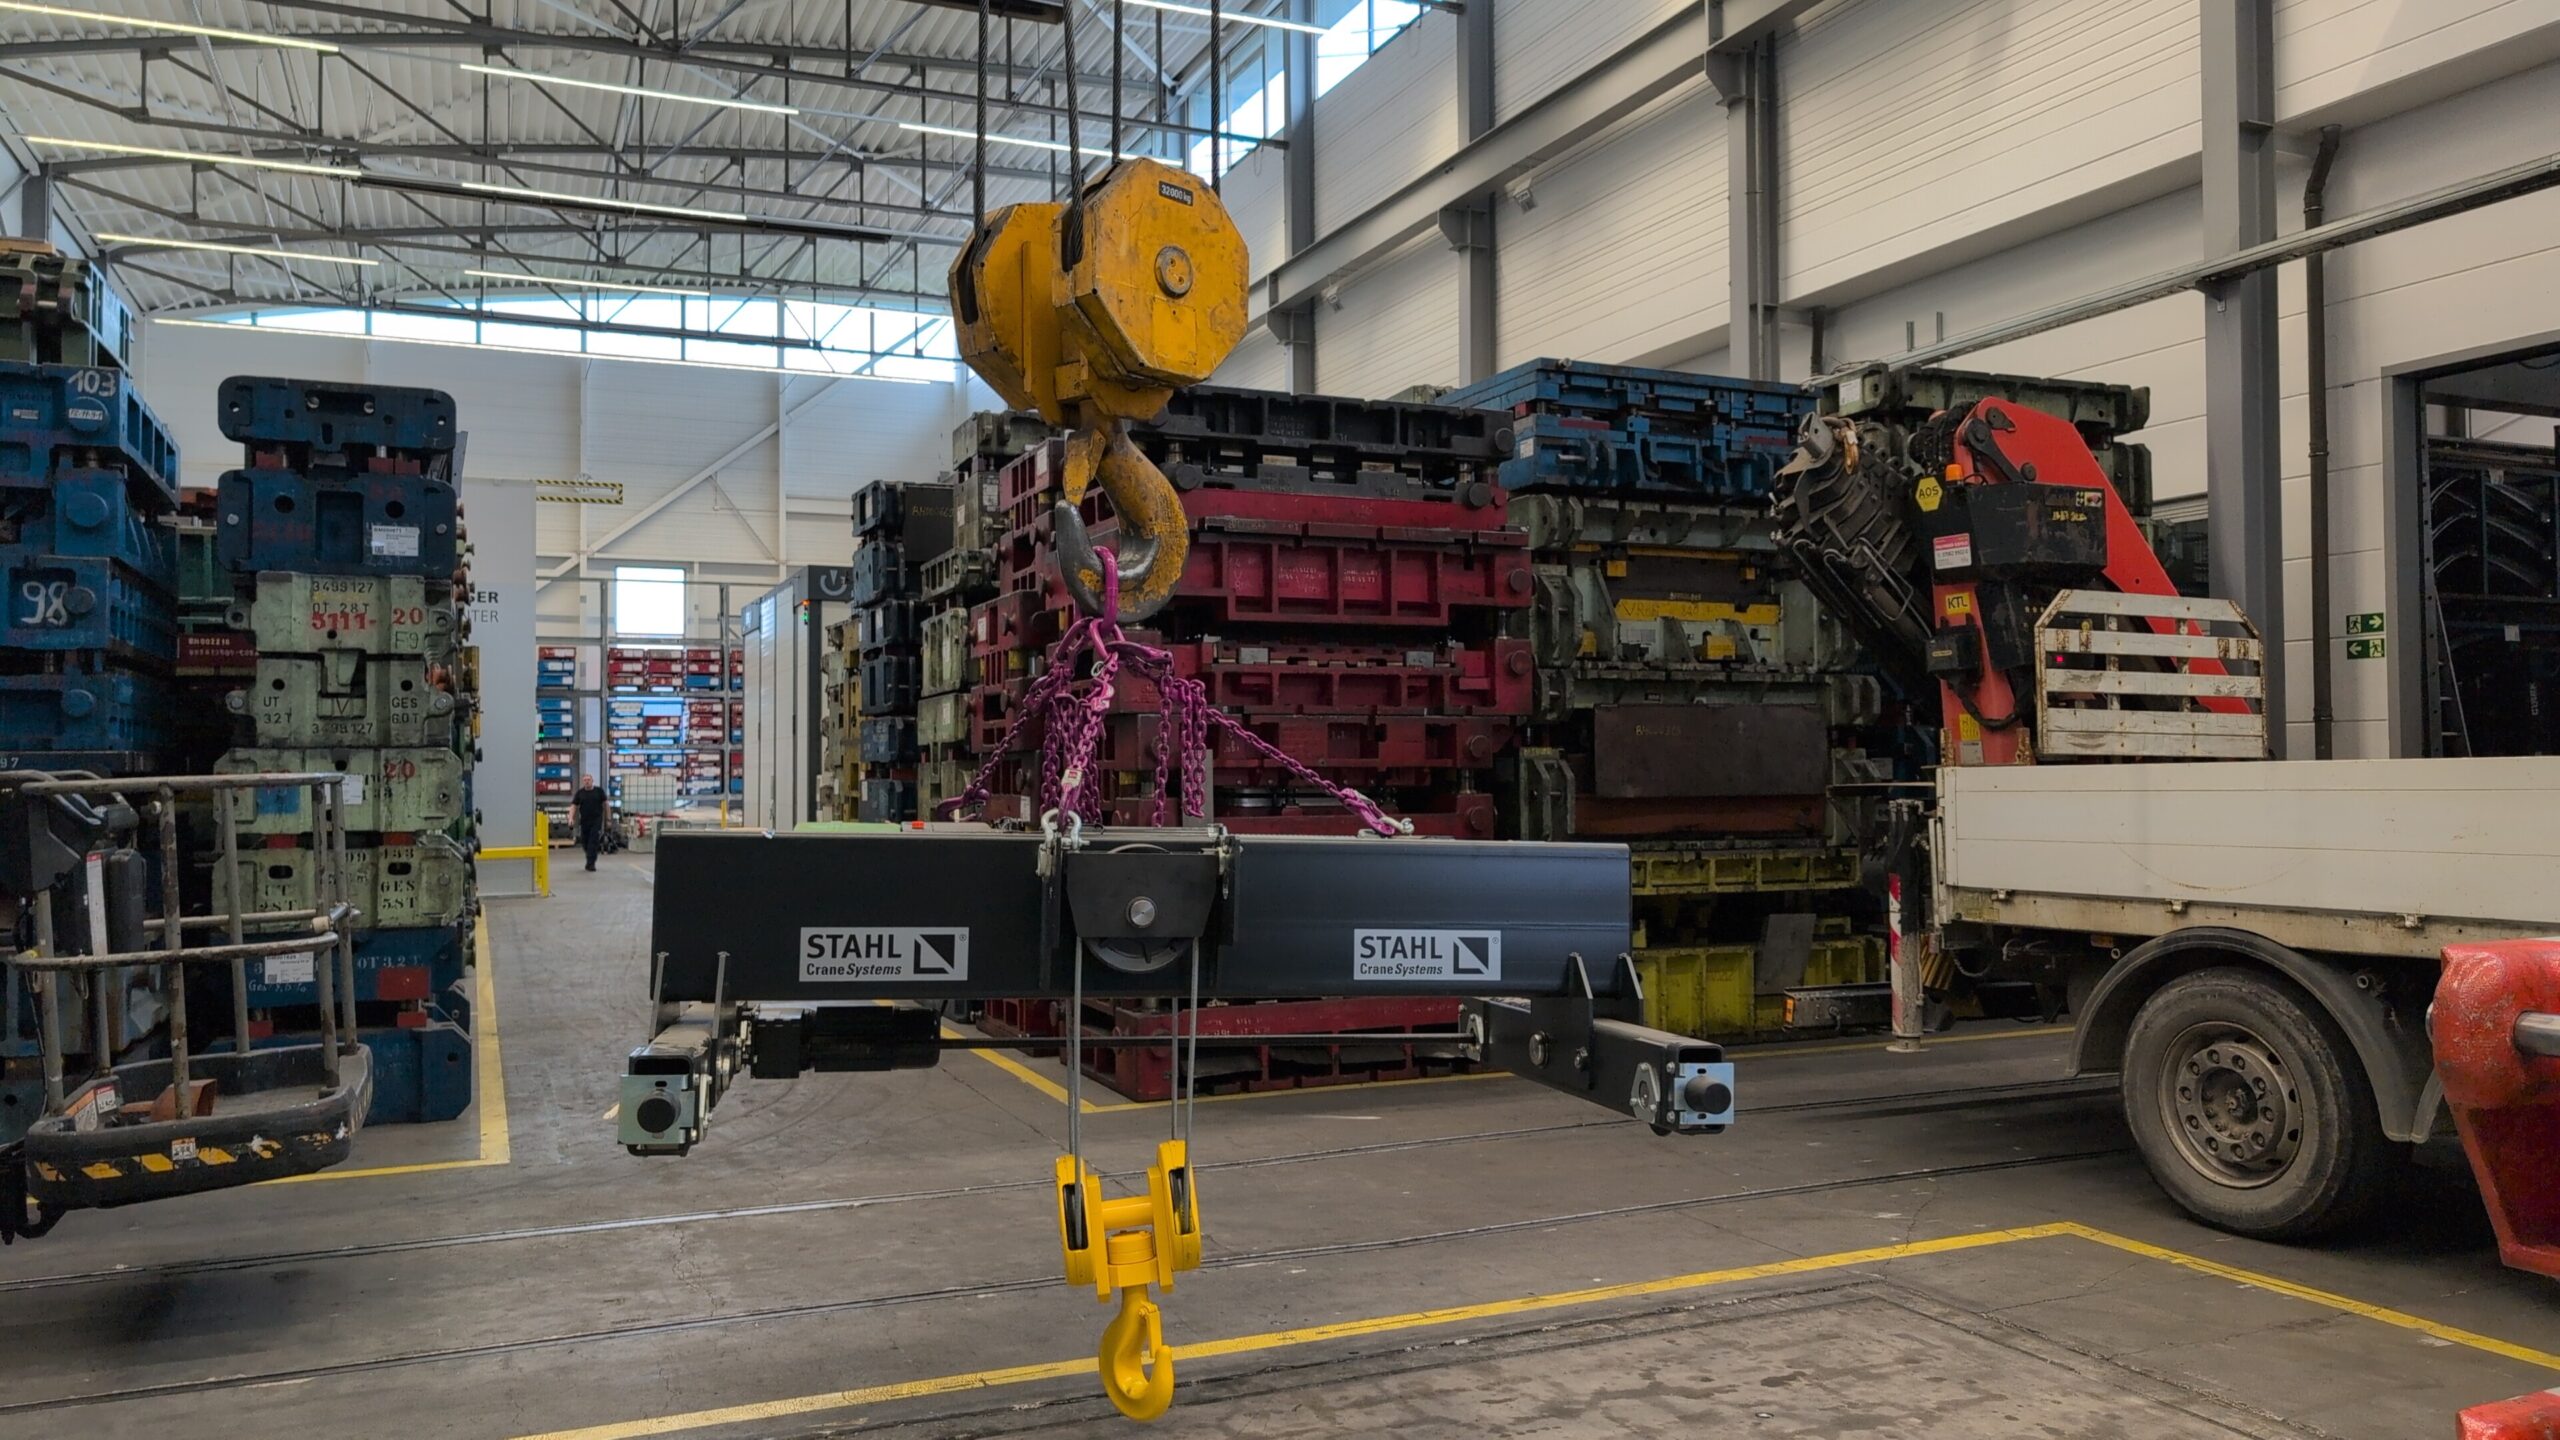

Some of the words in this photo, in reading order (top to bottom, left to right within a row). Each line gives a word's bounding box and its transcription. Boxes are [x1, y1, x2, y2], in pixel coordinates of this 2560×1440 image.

[67, 369, 117, 397] 103
[1919, 486, 1939, 499] AOS
[312, 580, 374, 593] 3499127
[20, 581, 68, 626] 98
[1947, 595, 1969, 609] KTL
[393, 607, 424, 625] 20
[263, 696, 280, 708] UT
[391, 696, 418, 709] GES
[806, 933, 902, 959] STAHL
[1360, 936, 1443, 959] STAHL
